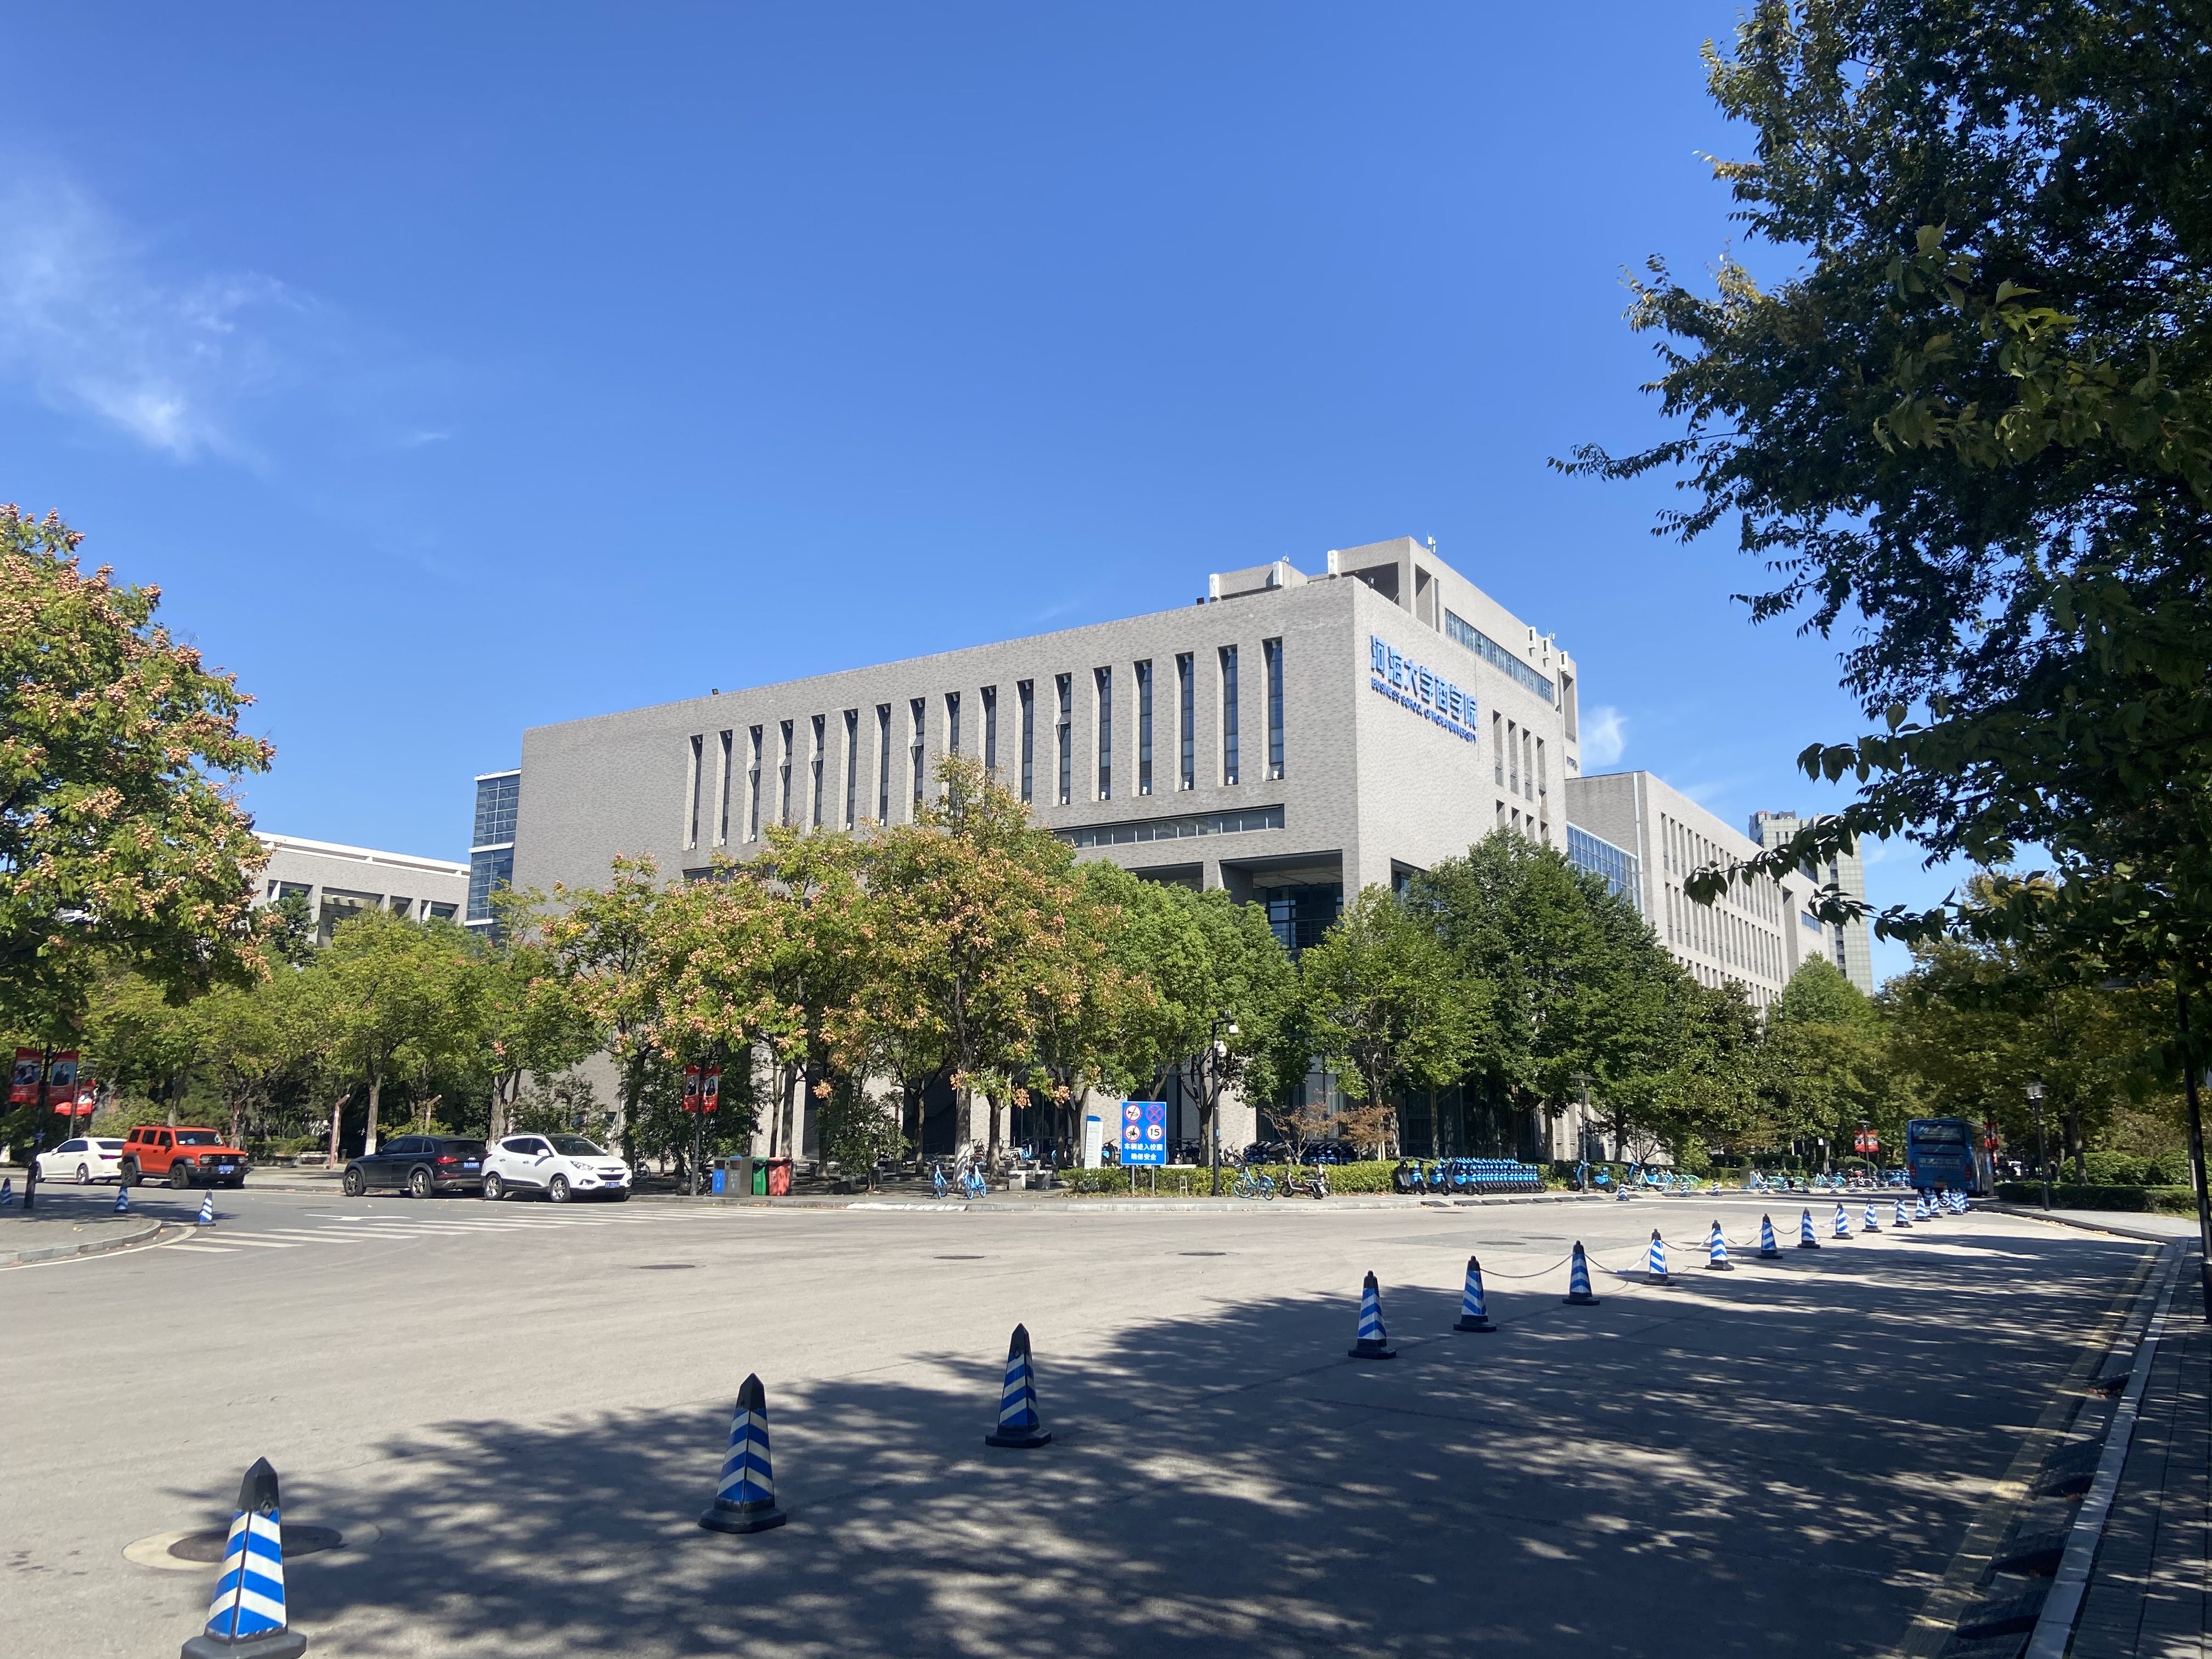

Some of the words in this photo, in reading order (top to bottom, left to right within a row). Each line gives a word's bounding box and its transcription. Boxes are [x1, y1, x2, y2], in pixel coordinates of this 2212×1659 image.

[1371, 677, 1400, 703] BUSINESS
[1401, 695, 1422, 716] SCHOOL
[1448, 720, 1476, 744] UNIVERSITY
[1124, 1143, 1163, 1151] 车辆进入校园
